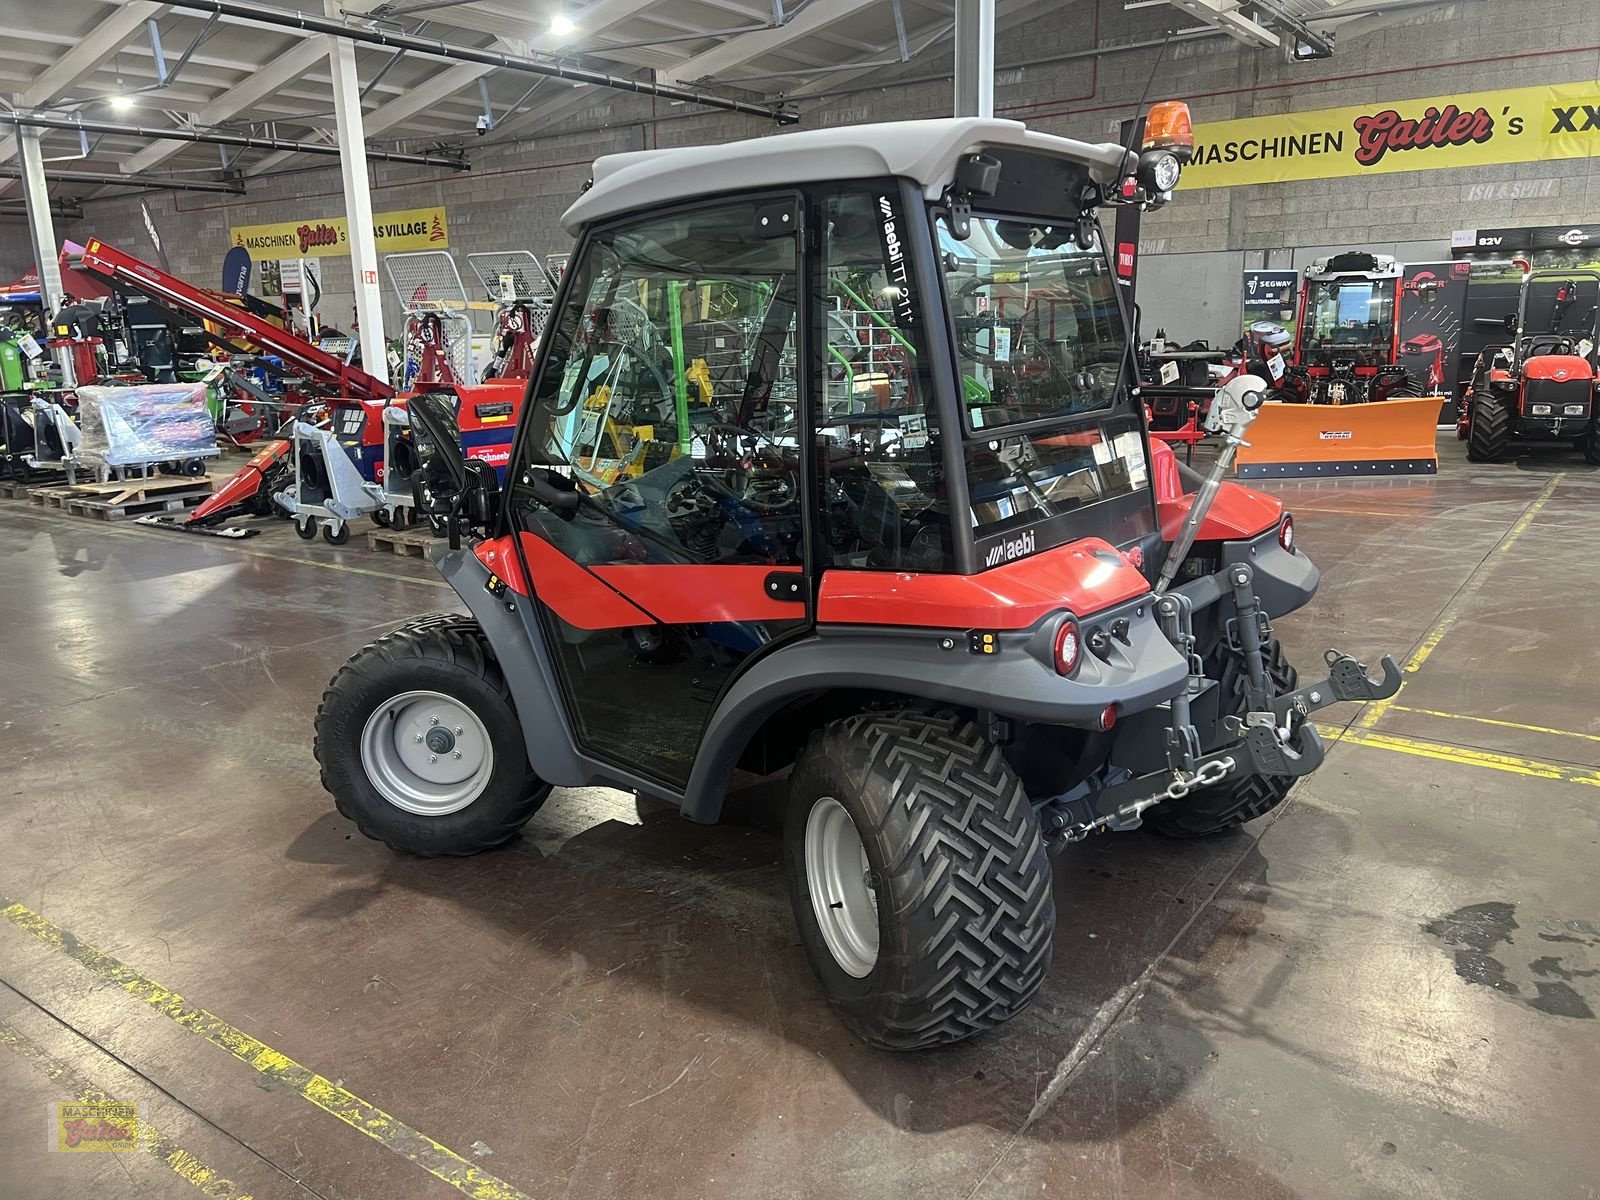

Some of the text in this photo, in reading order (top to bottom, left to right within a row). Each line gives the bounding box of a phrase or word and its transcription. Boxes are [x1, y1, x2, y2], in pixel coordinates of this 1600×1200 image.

[1184, 131, 1343, 167] MASCHINEN
[1353, 104, 1494, 167] Gailer
[246, 234, 296, 249] MASCHINEN
[297, 223, 338, 254] Gailer
[385, 221, 428, 238] VILLAGE
[884, 220, 904, 262] aebi
[1479, 236, 1503, 246] 82V
[1119, 253, 1133, 266] TORO
[1260, 280, 1292, 288] SEGWAY
[1006, 529, 1036, 560] aebi
